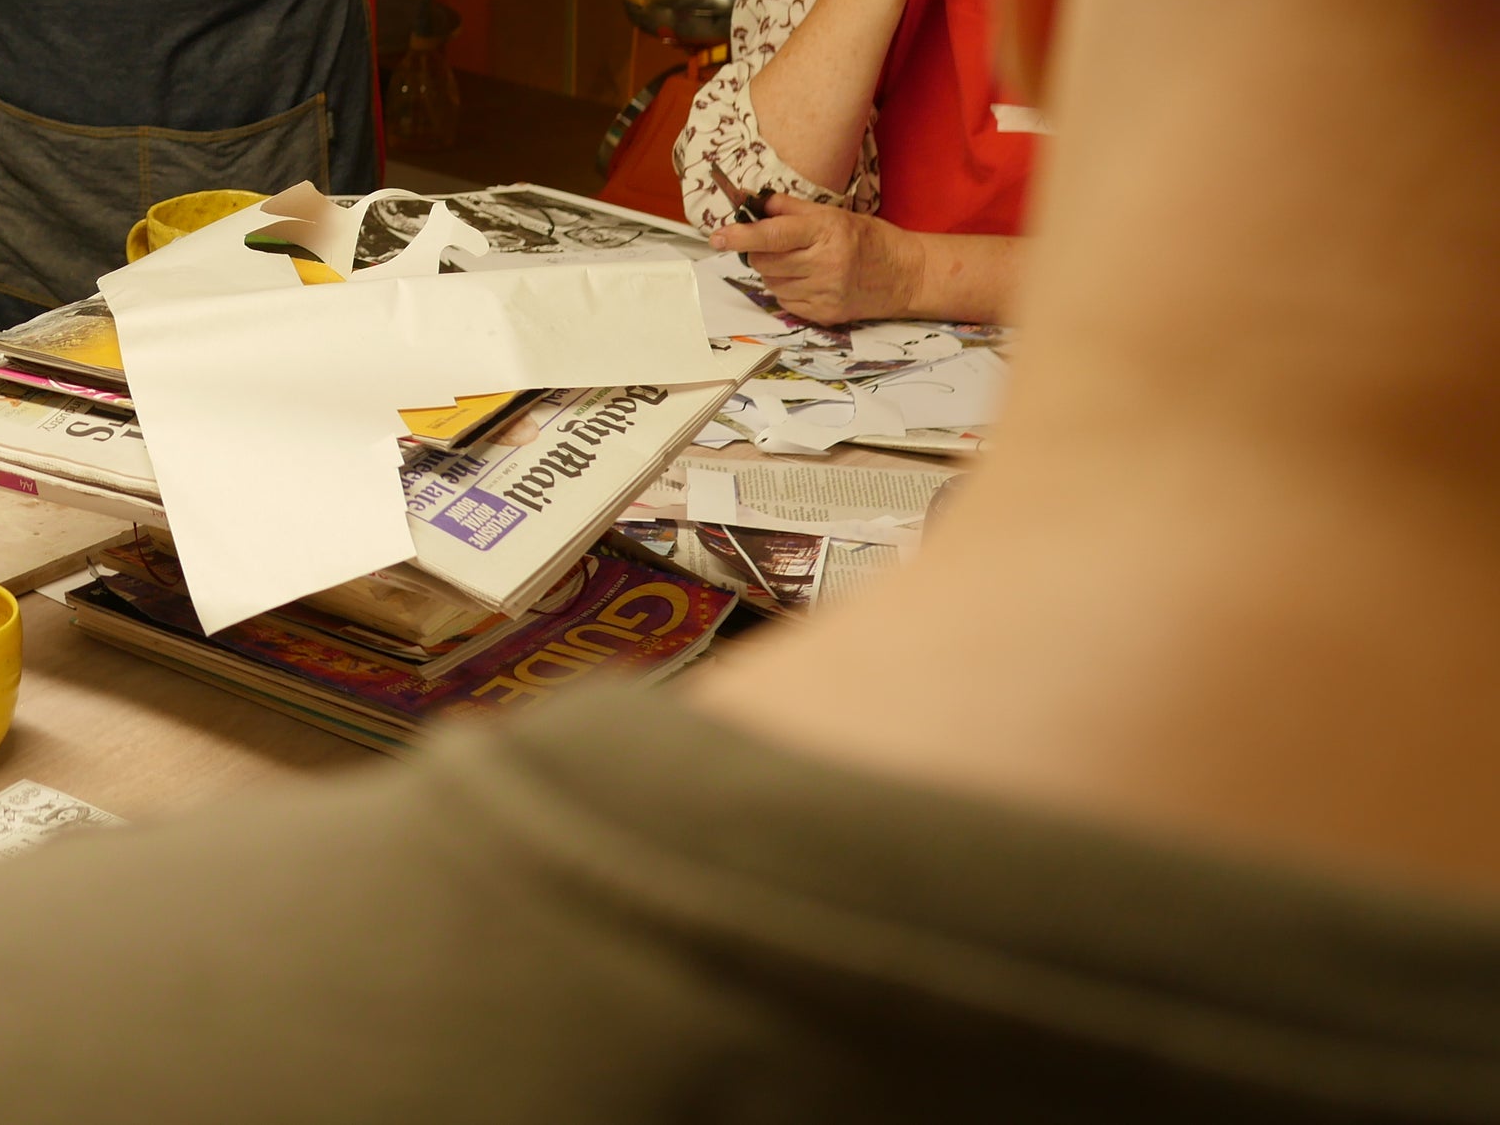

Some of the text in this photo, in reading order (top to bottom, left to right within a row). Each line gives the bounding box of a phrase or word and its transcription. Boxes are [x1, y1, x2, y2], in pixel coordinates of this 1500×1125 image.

[502, 385, 669, 513] Daily Mail
[19, 477, 34, 492] A4
[439, 453, 489, 484] The
[406, 481, 456, 514] late
[444, 497, 479, 523] BOOK
[459, 502, 498, 533] ROYAL
[467, 505, 521, 550] EXPLOSIVE
[470, 581, 690, 709] GUIDE
